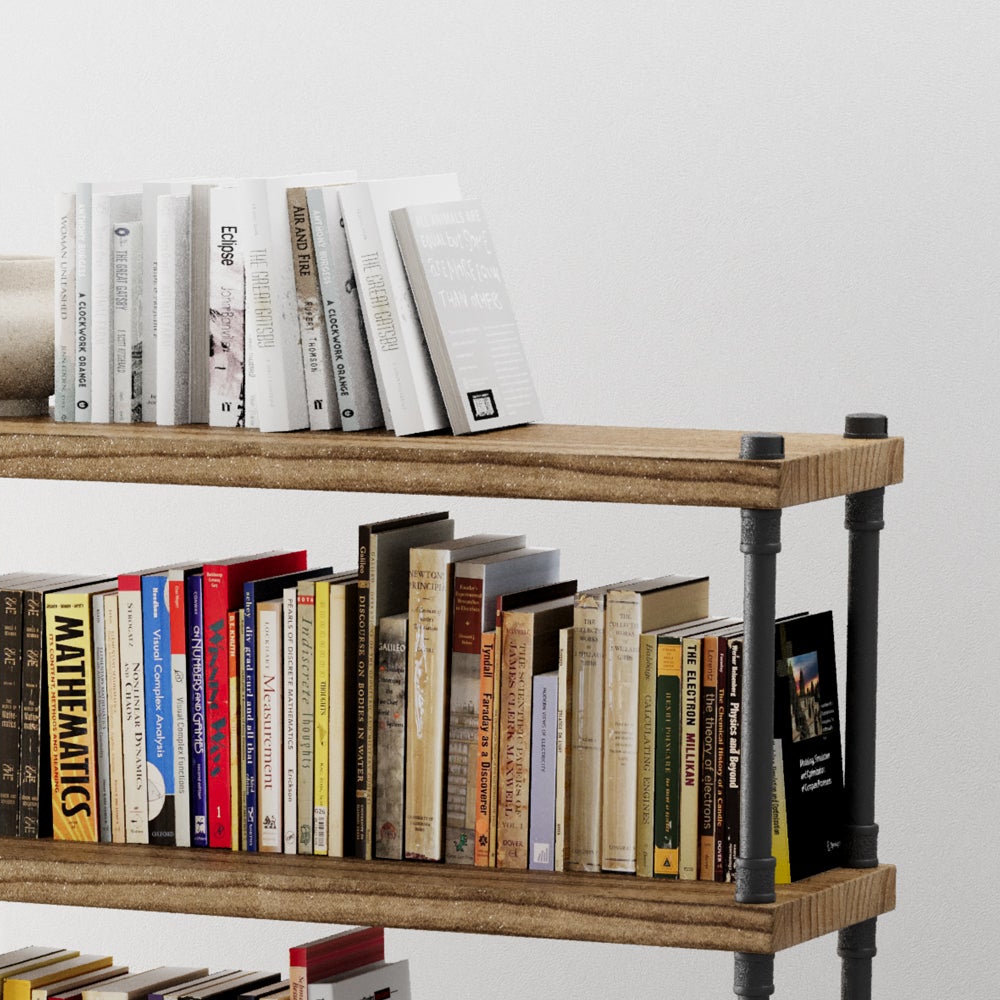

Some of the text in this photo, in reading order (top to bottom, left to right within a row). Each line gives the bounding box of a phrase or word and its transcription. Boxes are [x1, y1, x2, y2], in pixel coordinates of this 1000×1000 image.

[218, 226, 237, 265] Eclipse
[116, 251, 127, 310] THE GREAT GATSBY
[328, 309, 342, 360] CLOCKWORK
[336, 364, 349, 396] ORANGE
[359, 546, 367, 573] Galileo
[482, 644, 493, 677] Tyndall
[707, 649, 715, 681] Lorentz
[154, 665, 162, 710] Complex
[301, 616, 314, 768] Indiscrete Thoughts
[55, 616, 90, 817] MATHEMATICS
[263, 675, 276, 791] Measurement
[480, 693, 491, 733] Faraday
[685, 645, 697, 786] THE ELECTRON MILLIKAN
[155, 715, 164, 758] Analysis
[176, 722, 185, 754] Complex
[481, 736, 490, 745] as
[728, 703, 739, 788] Physics and Beyond
[178, 757, 186, 794] Functions
[703, 693, 715, 829] the theory of electrons
[480, 761, 491, 816] Discoverer
